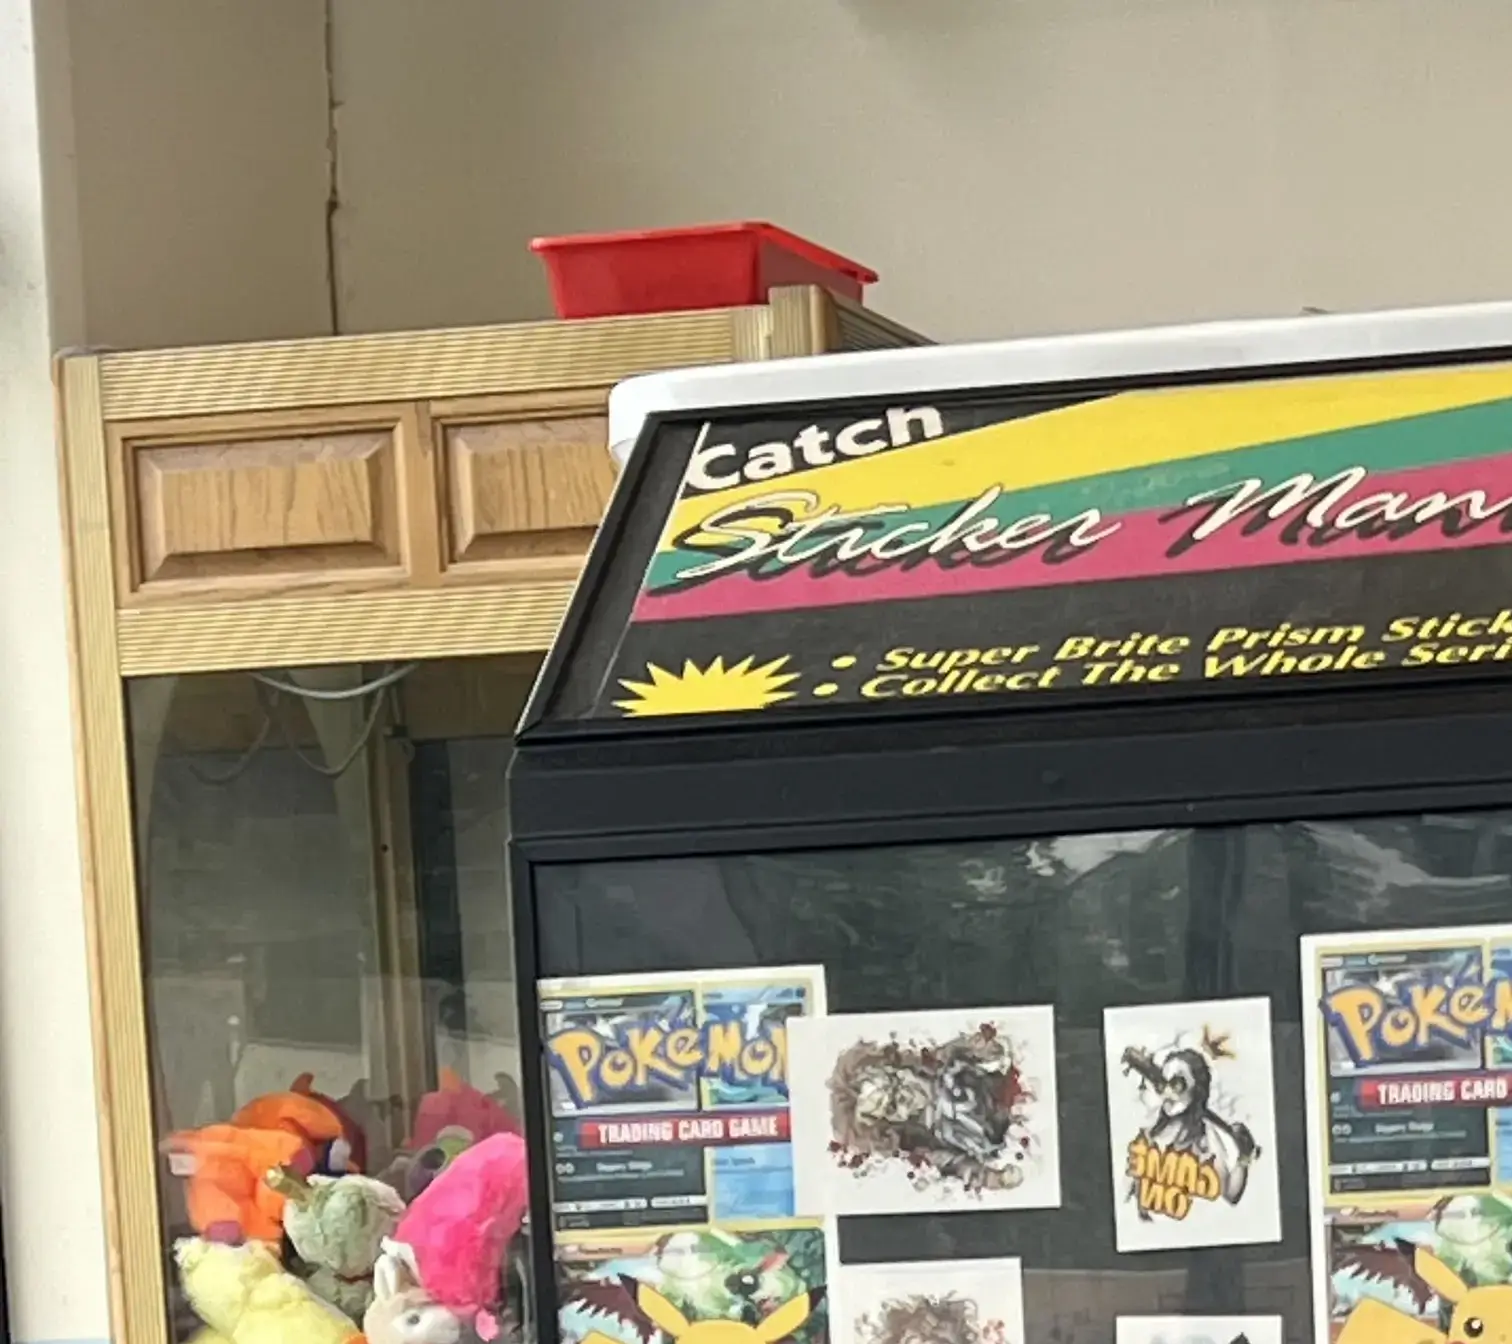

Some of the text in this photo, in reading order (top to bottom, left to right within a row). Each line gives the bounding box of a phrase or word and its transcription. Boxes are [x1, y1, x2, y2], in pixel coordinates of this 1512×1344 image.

[685, 404, 945, 491] Catch
[675, 482, 1122, 580] Sticker
[859, 664, 1062, 698] Collect
[1081, 658, 1181, 686] The
[1203, 645, 1386, 679] Whole
[875, 644, 1041, 675] Super
[1053, 631, 1191, 661] Brite
[1205, 621, 1367, 652] Prism
[1376, 1078, 1454, 1105] TRADING
[1460, 1076, 1508, 1100] CARD
[598, 1115, 778, 1144] TRADING CARD GAME
